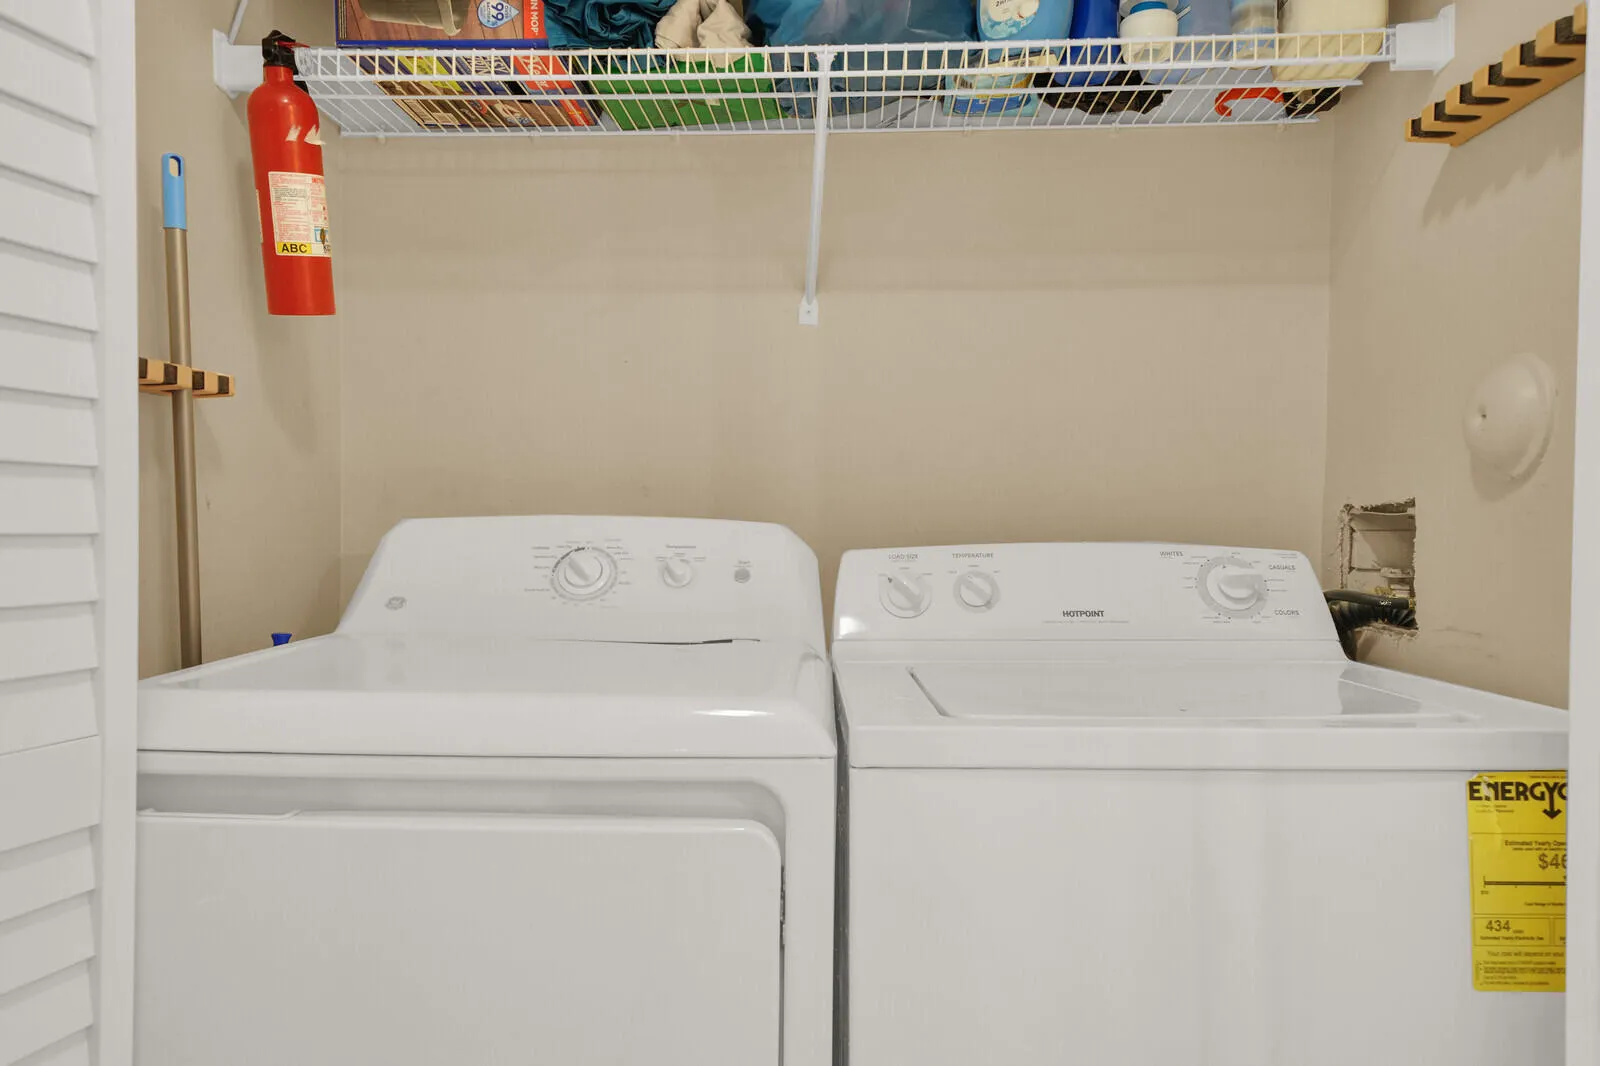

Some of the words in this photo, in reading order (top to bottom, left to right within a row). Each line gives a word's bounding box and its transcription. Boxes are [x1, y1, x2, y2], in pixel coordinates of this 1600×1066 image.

[530, 11, 539, 33] MOP
[281, 243, 308, 253] ABC
[1062, 610, 1105, 618] HOTPOINT
[1485, 919, 1511, 932] 434
